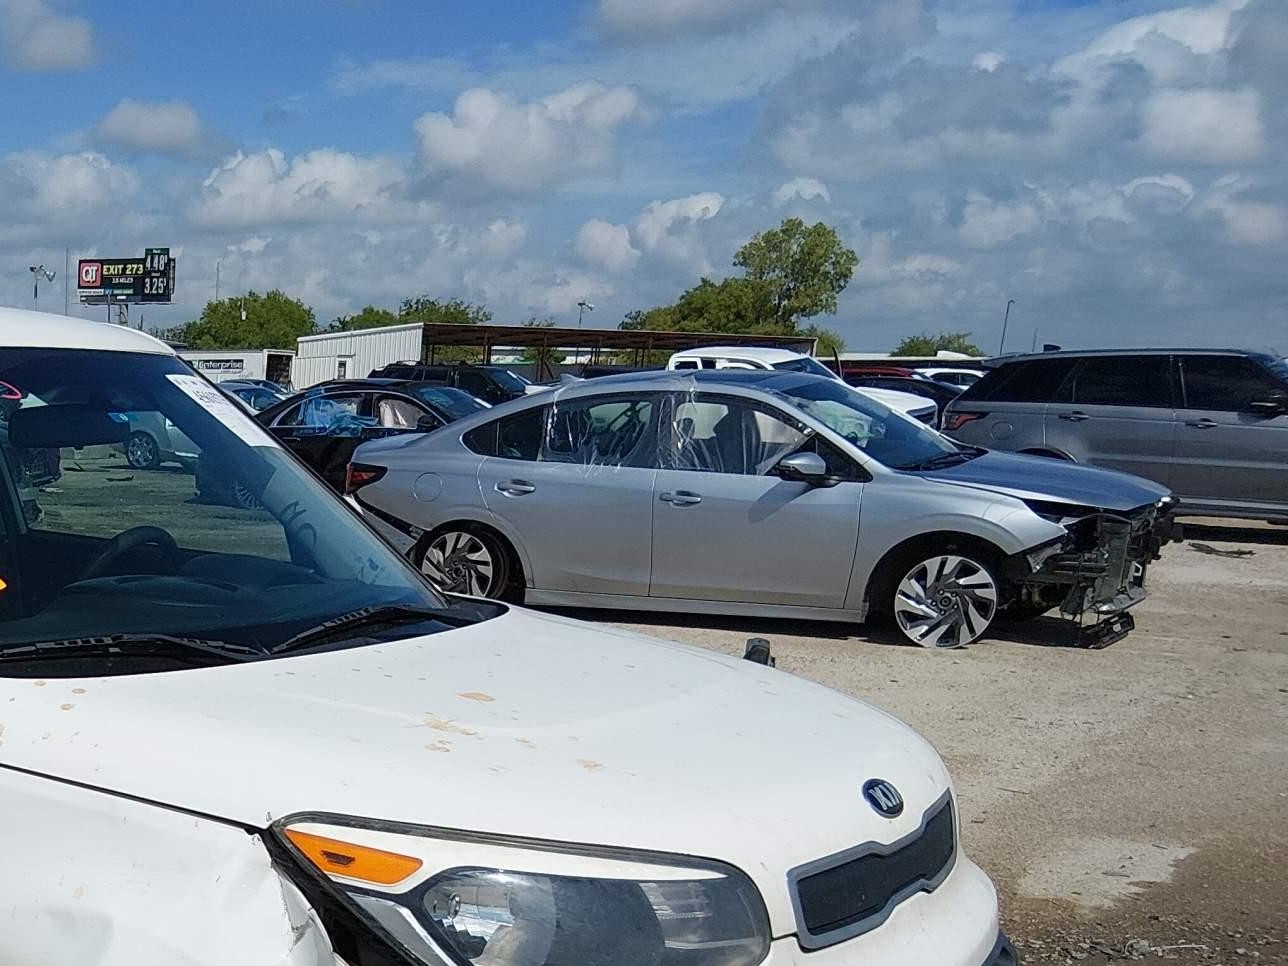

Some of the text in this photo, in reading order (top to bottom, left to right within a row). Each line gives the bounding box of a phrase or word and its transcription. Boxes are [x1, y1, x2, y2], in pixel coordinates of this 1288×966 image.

[82, 266, 98, 283] QT
[102, 264, 125, 275] EXIT
[125, 263, 144, 275] 273
